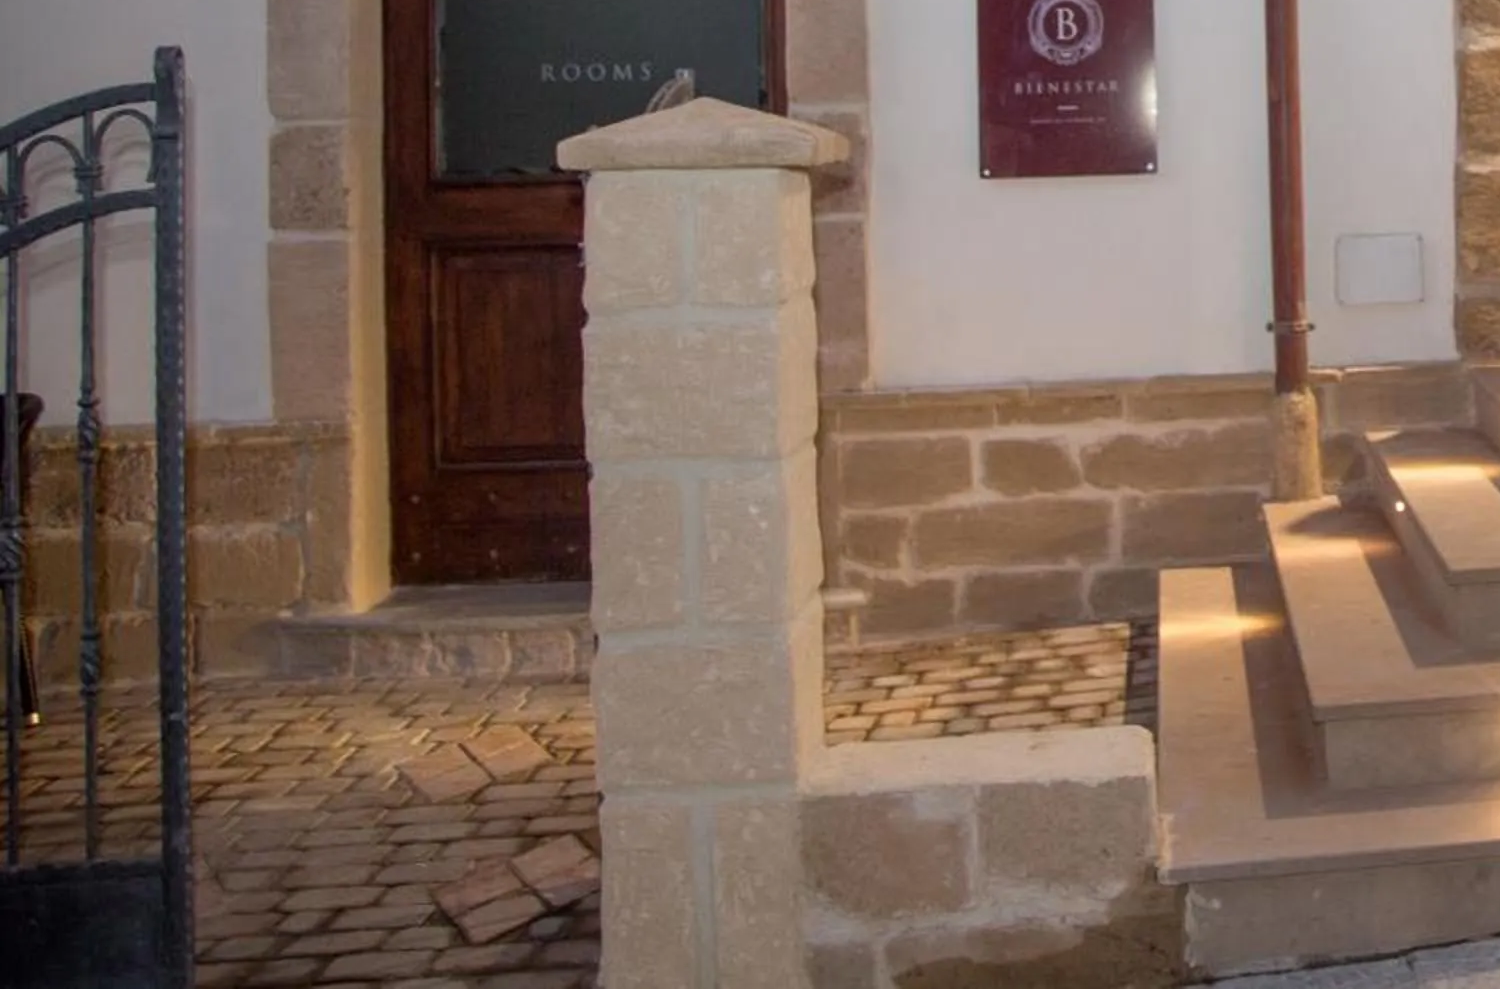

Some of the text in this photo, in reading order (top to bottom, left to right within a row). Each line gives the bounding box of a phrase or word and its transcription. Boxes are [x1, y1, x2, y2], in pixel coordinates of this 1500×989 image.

[1055, 7, 1079, 41] B
[540, 61, 652, 82] ROOMS
[1014, 80, 1119, 95] BIENESTAR
